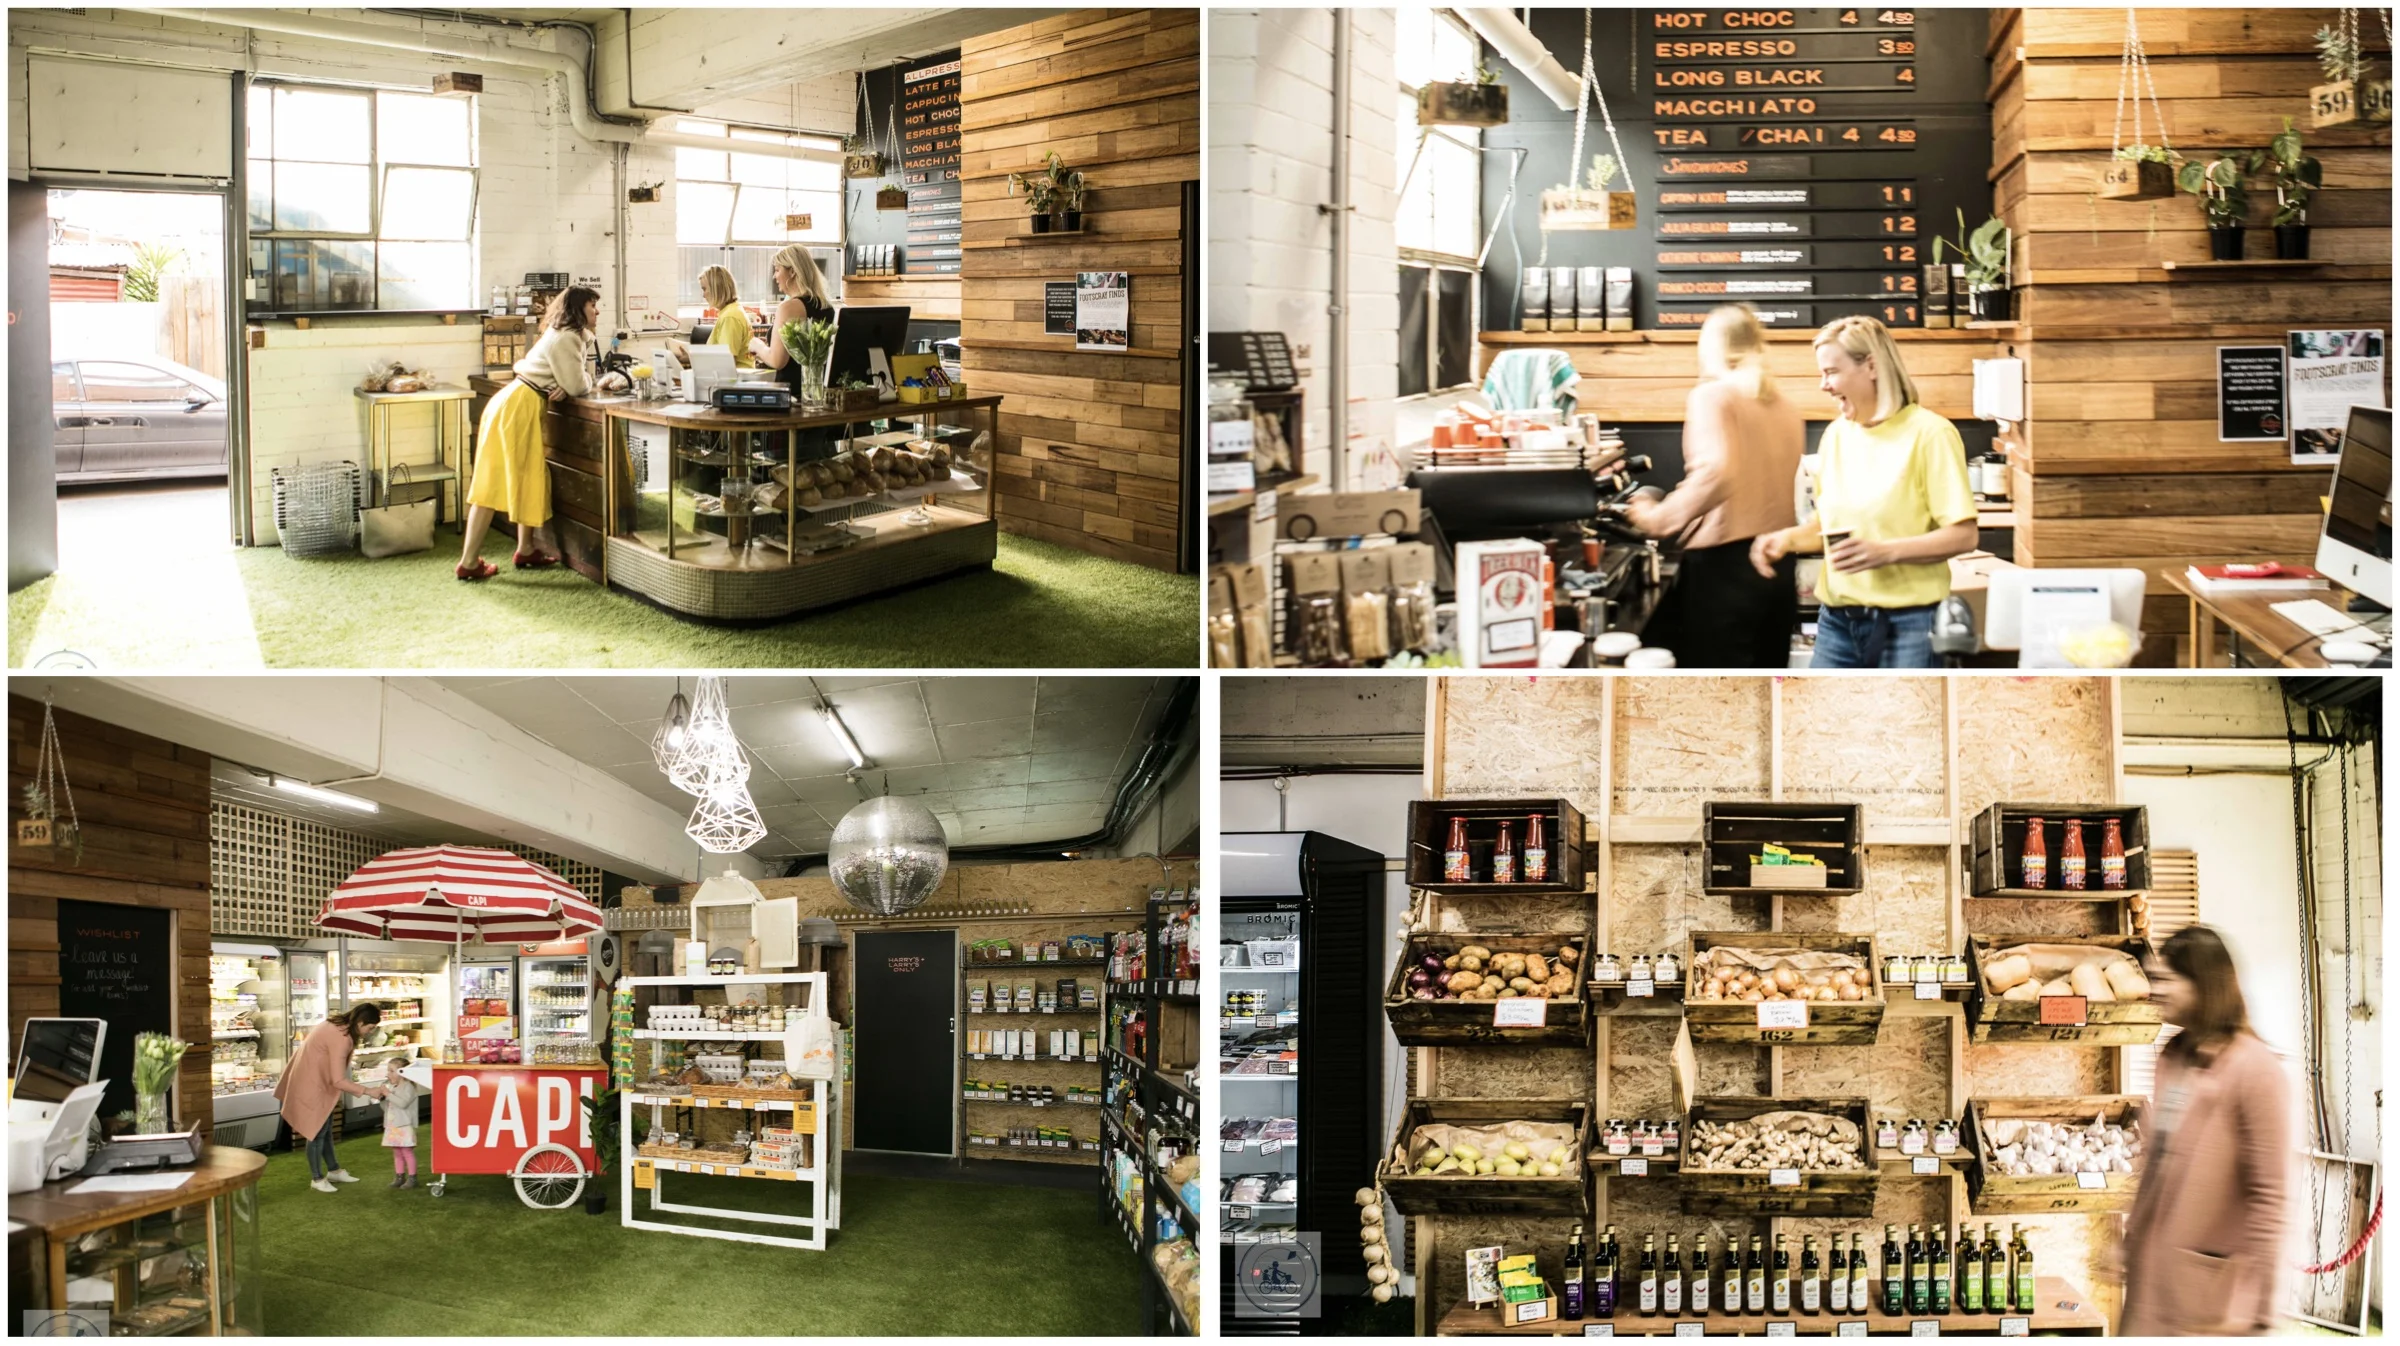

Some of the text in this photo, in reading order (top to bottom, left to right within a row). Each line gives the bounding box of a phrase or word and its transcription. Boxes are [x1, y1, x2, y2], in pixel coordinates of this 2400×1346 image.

[1655, 14, 1707, 28] HOT
[1723, 11, 1795, 26] CHOC
[1841, 11, 1858, 24] 4
[1656, 40, 1796, 57] ESPRESSO
[905, 62, 960, 81] ALLPRESS
[1656, 69, 1914, 86] LONG BLACK 4
[905, 78, 961, 95] LATTE FL
[1655, 98, 1816, 115] MACCHIATO
[2318, 91, 2347, 116] 59
[905, 108, 960, 125] HOT CHOC
[1654, 130, 1708, 144] TEA
[1842, 128, 1860, 142] 4
[905, 143, 932, 155] LONG
[905, 174, 926, 183] TEA
[1080, 290, 1125, 302] FOOTSCRAY FINDS
[2294, 360, 2379, 381] FOOTSCRAY FINDS
[23, 825, 47, 839] 59
[467, 895, 487, 906] CAPI
[1247, 913, 1296, 924] BROMIC
[77, 928, 140, 940] WISHLIST
[460, 1017, 478, 1028] CAPI
[1761, 1030, 1794, 1041] 162
[446, 1075, 593, 1148] CAPI
